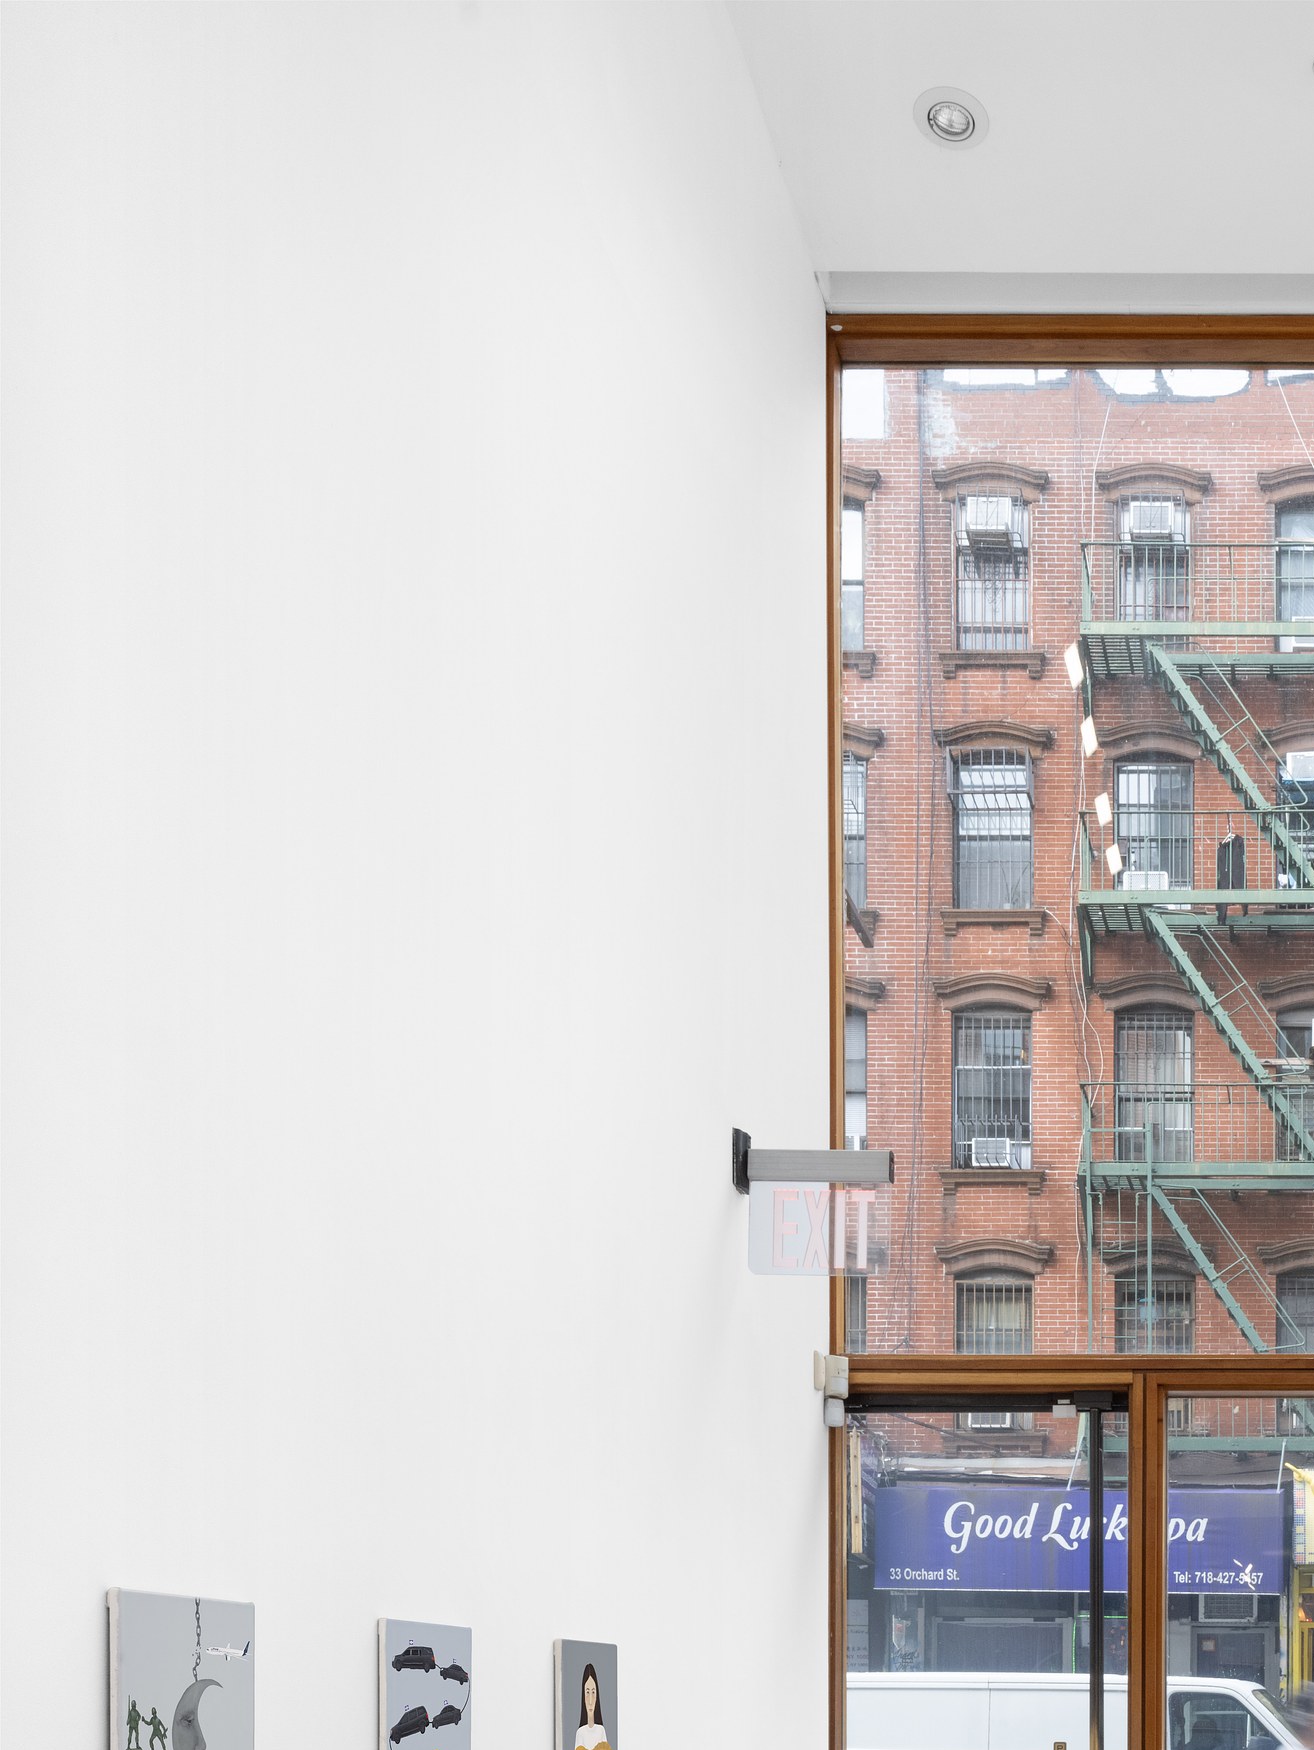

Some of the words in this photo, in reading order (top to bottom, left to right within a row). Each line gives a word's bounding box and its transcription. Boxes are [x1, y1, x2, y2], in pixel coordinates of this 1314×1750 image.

[773, 1188, 876, 1269] EXIT
[943, 1500, 1039, 1553] Good
[1042, 1502, 1128, 1551] Luk
[1168, 1517, 1209, 1542] pa
[889, 1567, 902, 1580] 33
[903, 1567, 944, 1581] Orchard
[946, 1568, 960, 1581] St.
[1173, 1571, 1192, 1584] Tel:
